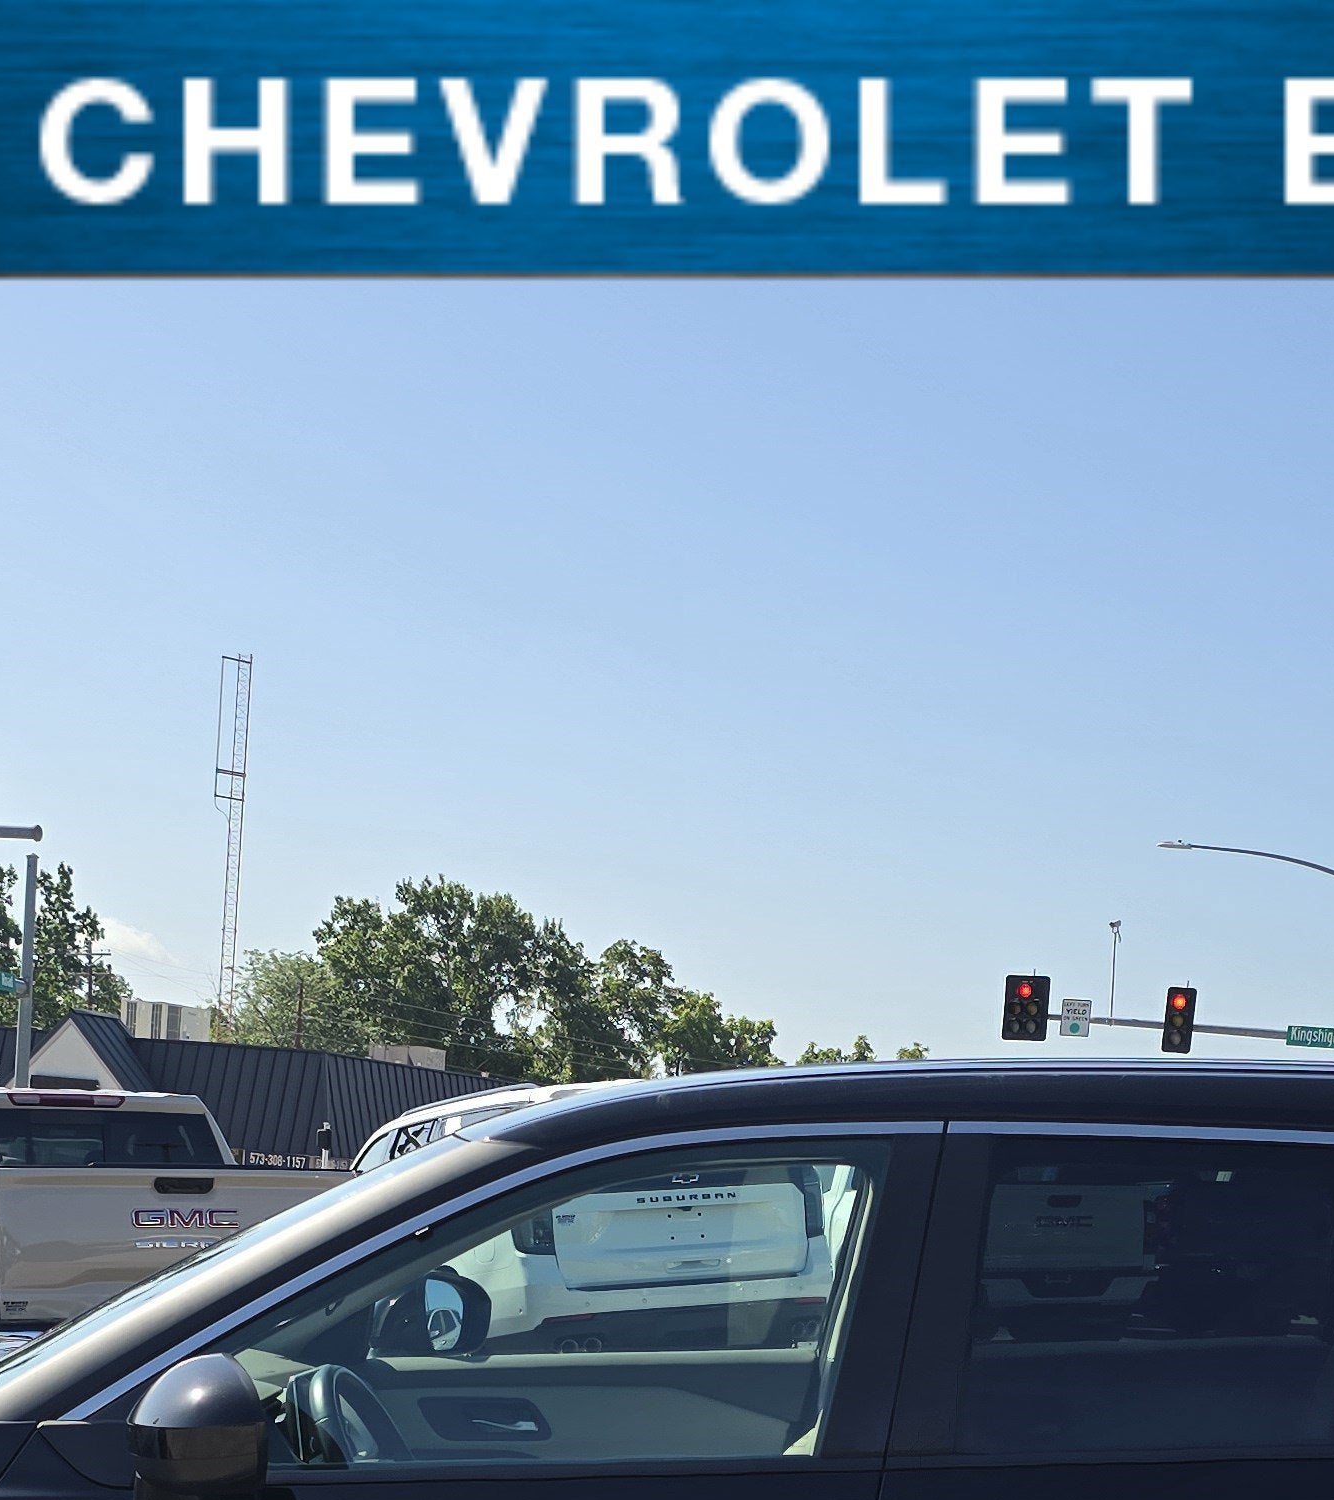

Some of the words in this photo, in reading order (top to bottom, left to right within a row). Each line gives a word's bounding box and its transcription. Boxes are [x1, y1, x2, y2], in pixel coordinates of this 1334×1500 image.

[1066, 1008, 1087, 1016] YIELD
[249, 1151, 306, 1169] 573-308-1157
[636, 1192, 736, 1204] SUBURBAN
[131, 1208, 240, 1228] GMC
